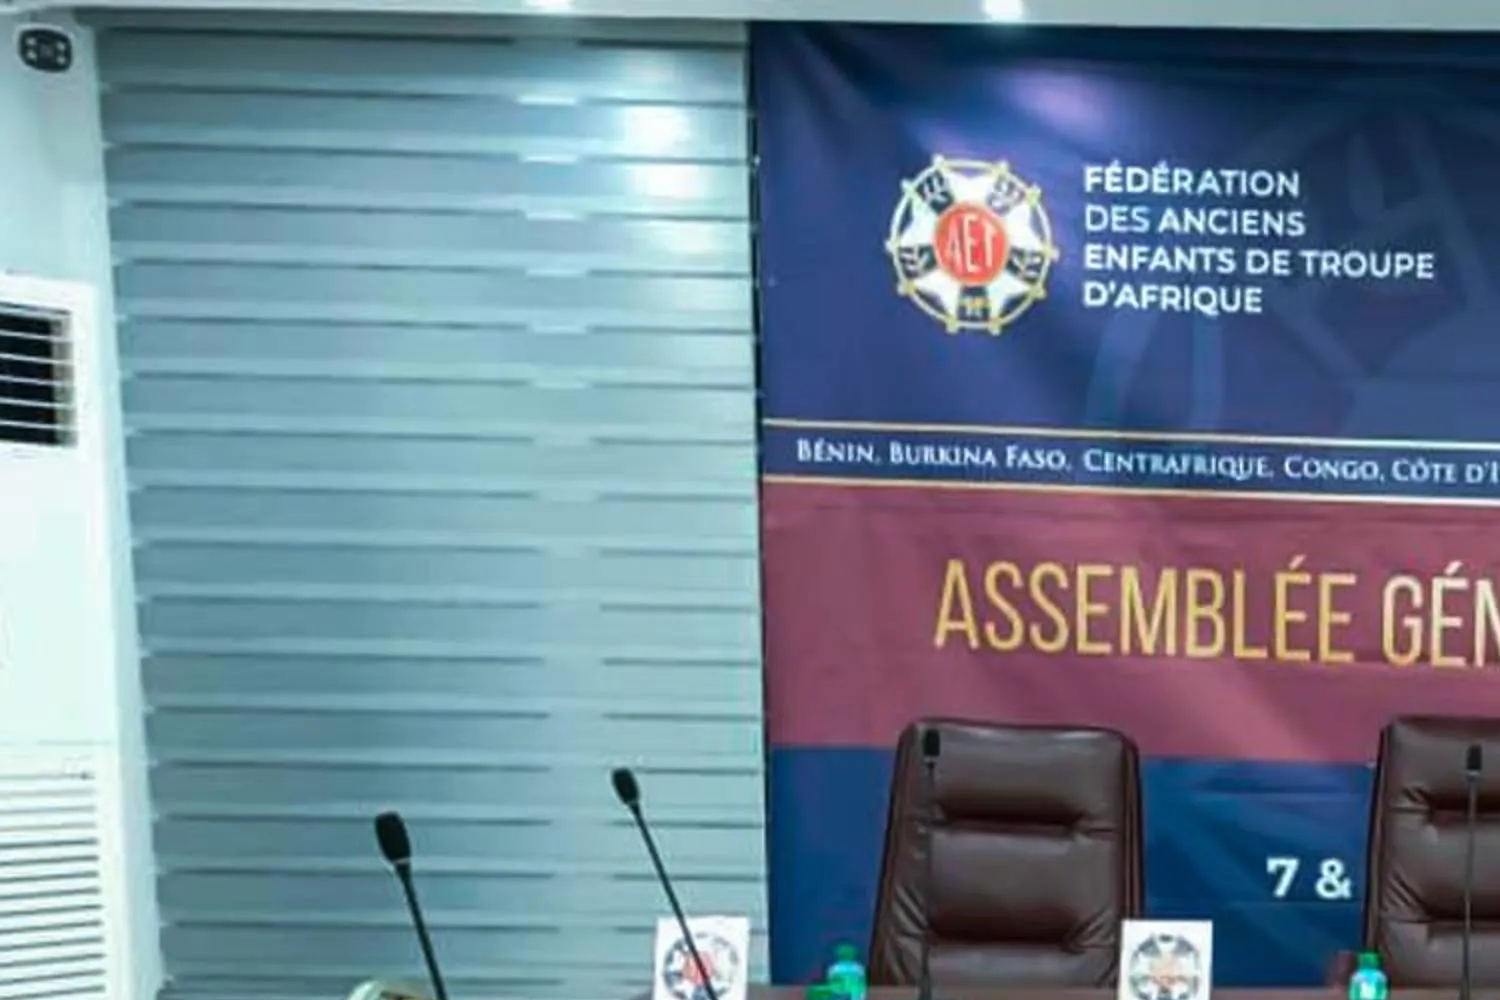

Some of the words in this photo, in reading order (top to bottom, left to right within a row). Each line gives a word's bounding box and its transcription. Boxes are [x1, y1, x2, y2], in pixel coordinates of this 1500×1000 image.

[1083, 160, 1300, 198] FÉDÉRATION
[1084, 204, 1150, 233] DES
[1158, 207, 1307, 237] ANCIENS
[945, 211, 997, 276] AET
[1083, 243, 1236, 274] ENFANTS
[1246, 249, 1292, 275] DE
[1301, 250, 1436, 279] TROUPE
[1083, 281, 1264, 317] D'AFRIQUE
[889, 440, 998, 467] BURKINA
[1284, 455, 1385, 483] CONGO,
[1391, 457, 1456, 483] CÔTE
[933, 556, 1357, 663] ASSEMBLÉE
[1266, 857, 1300, 898] 7
[1315, 858, 1352, 899] &
